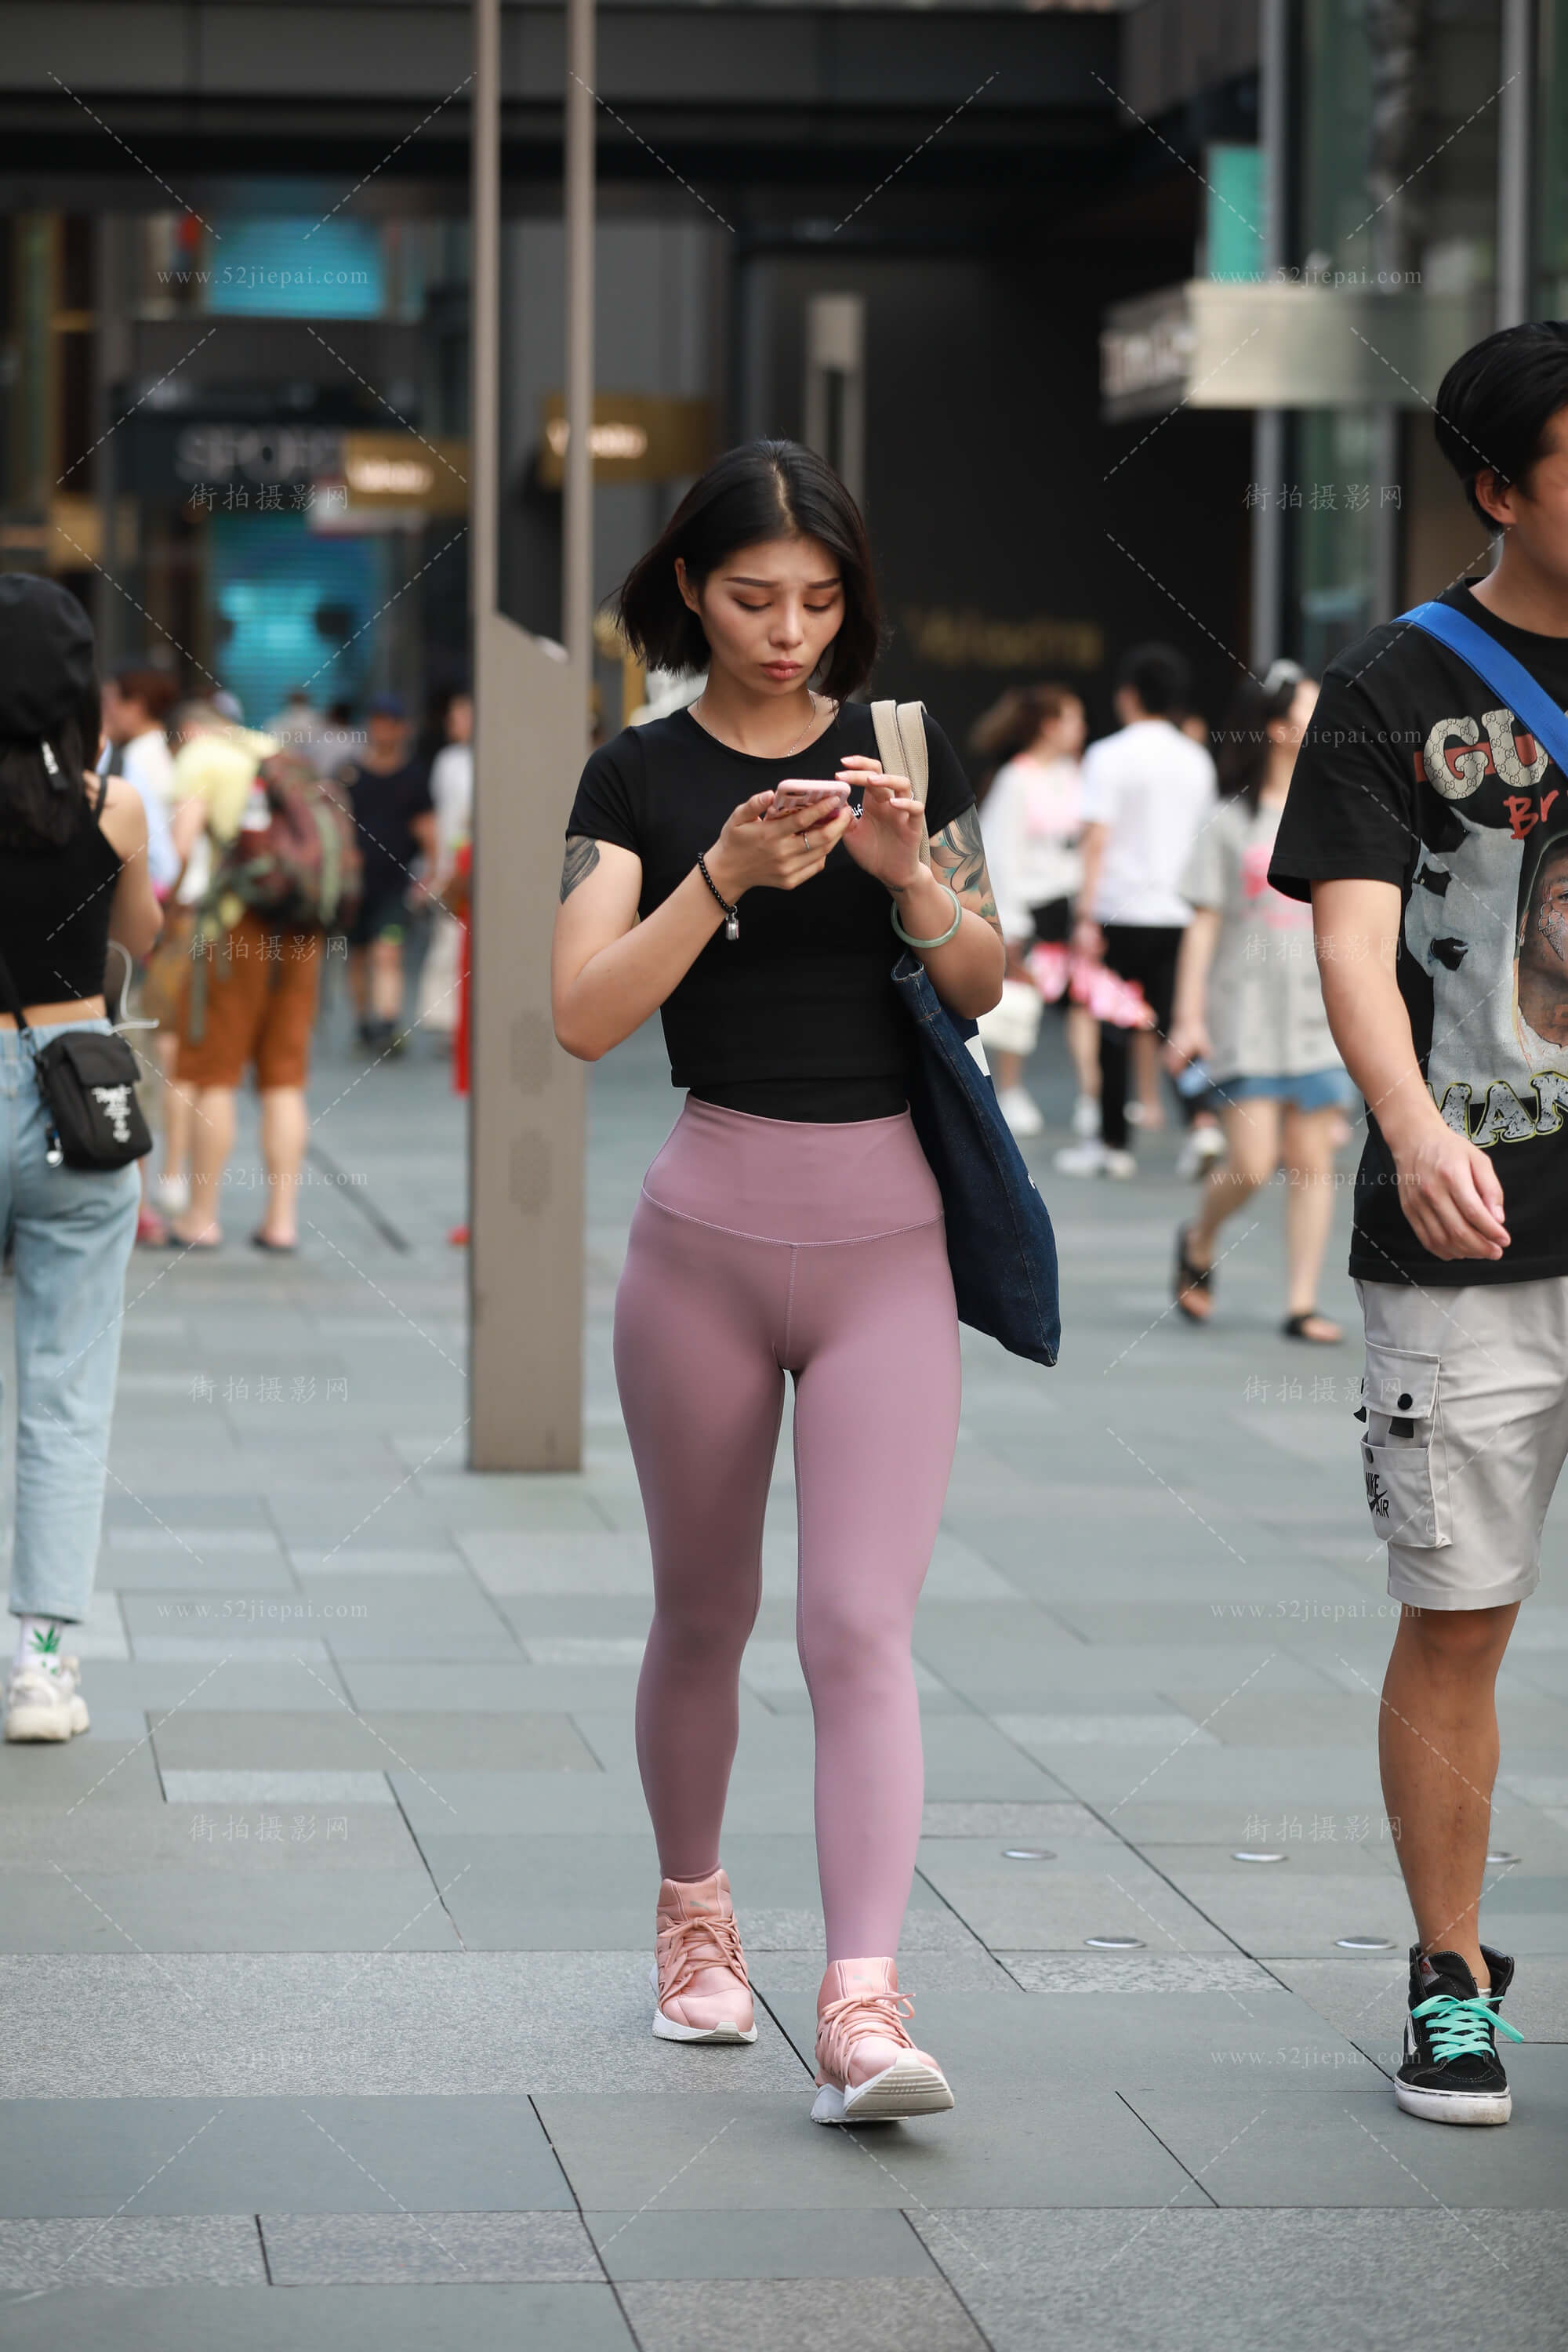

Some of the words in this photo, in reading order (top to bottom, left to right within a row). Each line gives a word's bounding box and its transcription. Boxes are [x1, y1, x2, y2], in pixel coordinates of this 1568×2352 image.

[1423, 708, 1568, 800] GU
[1503, 789, 1568, 840] Br
[1375, 1498, 1389, 1518] AIR
